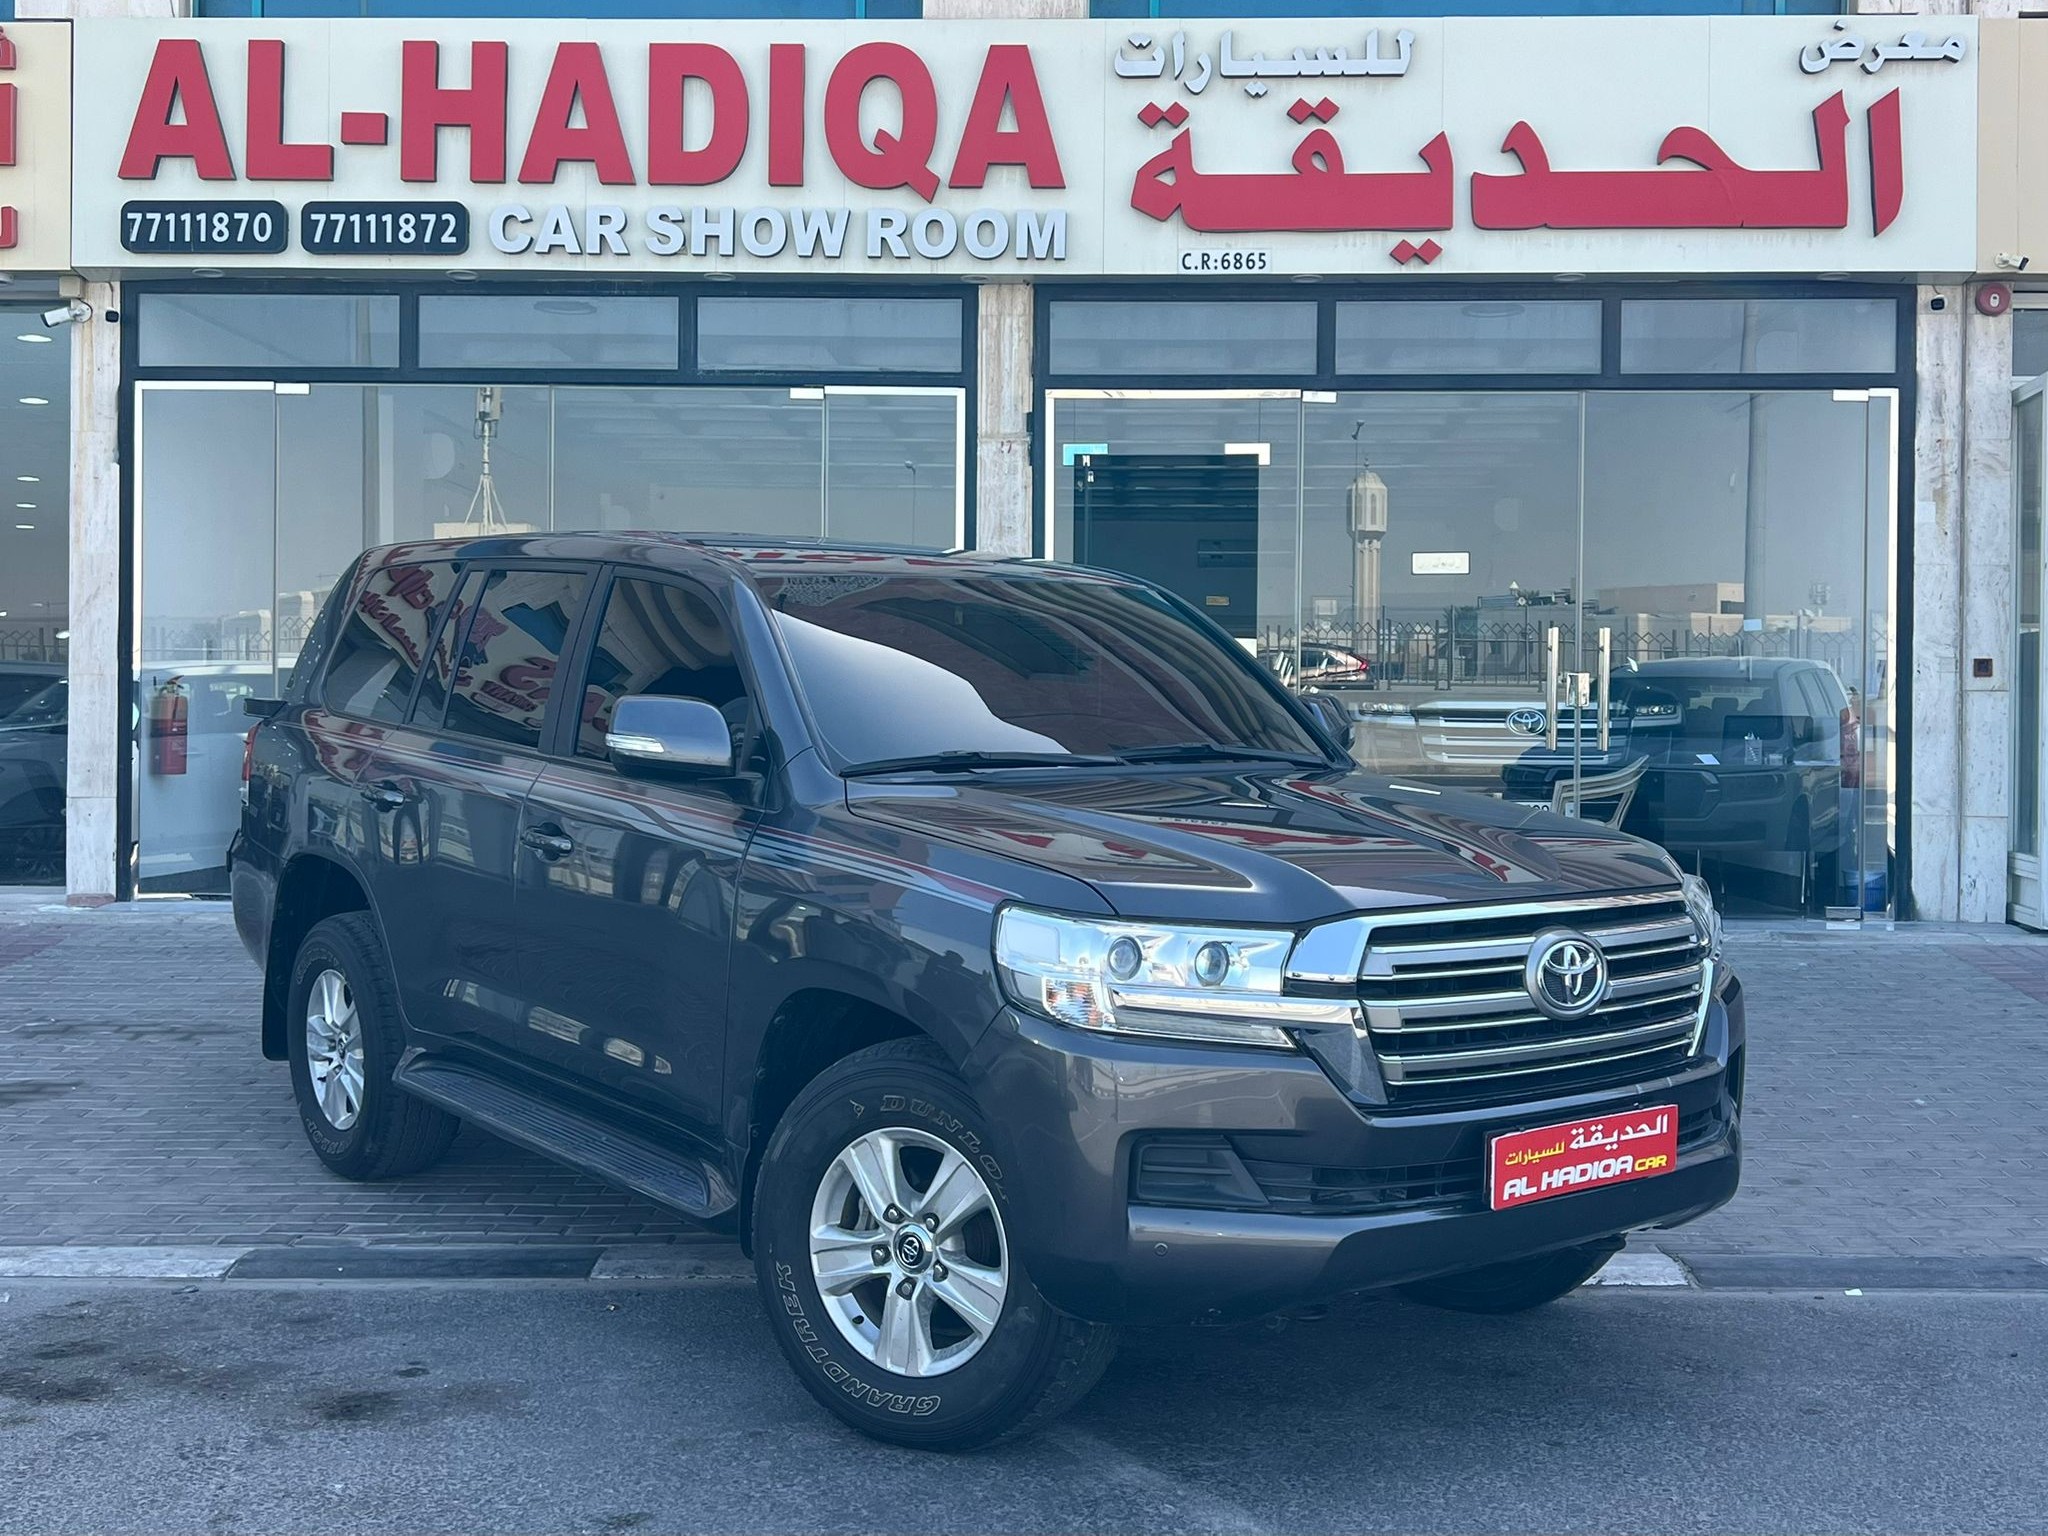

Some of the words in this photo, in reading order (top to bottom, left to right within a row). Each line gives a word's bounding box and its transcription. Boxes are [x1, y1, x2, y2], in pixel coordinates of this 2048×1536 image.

[1114, 27, 1417, 96] للسيارات
[1799, 20, 1967, 75] معرض
[118, 38, 1067, 204] AL-HADIQA
[1131, 86, 1904, 267] الحديقة
[127, 211, 273, 245] 77111870
[309, 212, 458, 245] 77111872
[488, 204, 631, 256] CAR
[645, 205, 851, 260] SHOW
[866, 207, 1067, 261] ROOM
[1181, 252, 1267, 271] C.R:6865
[1505, 1141, 1565, 1166] للسيارات
[1570, 1114, 1668, 1150] الحديقة
[1502, 1176, 1538, 1201] AL
[1541, 1156, 1633, 1191] HADIQA
[1635, 1155, 1667, 1171] CAR
[774, 1260, 942, 1417] GRANDTREK
